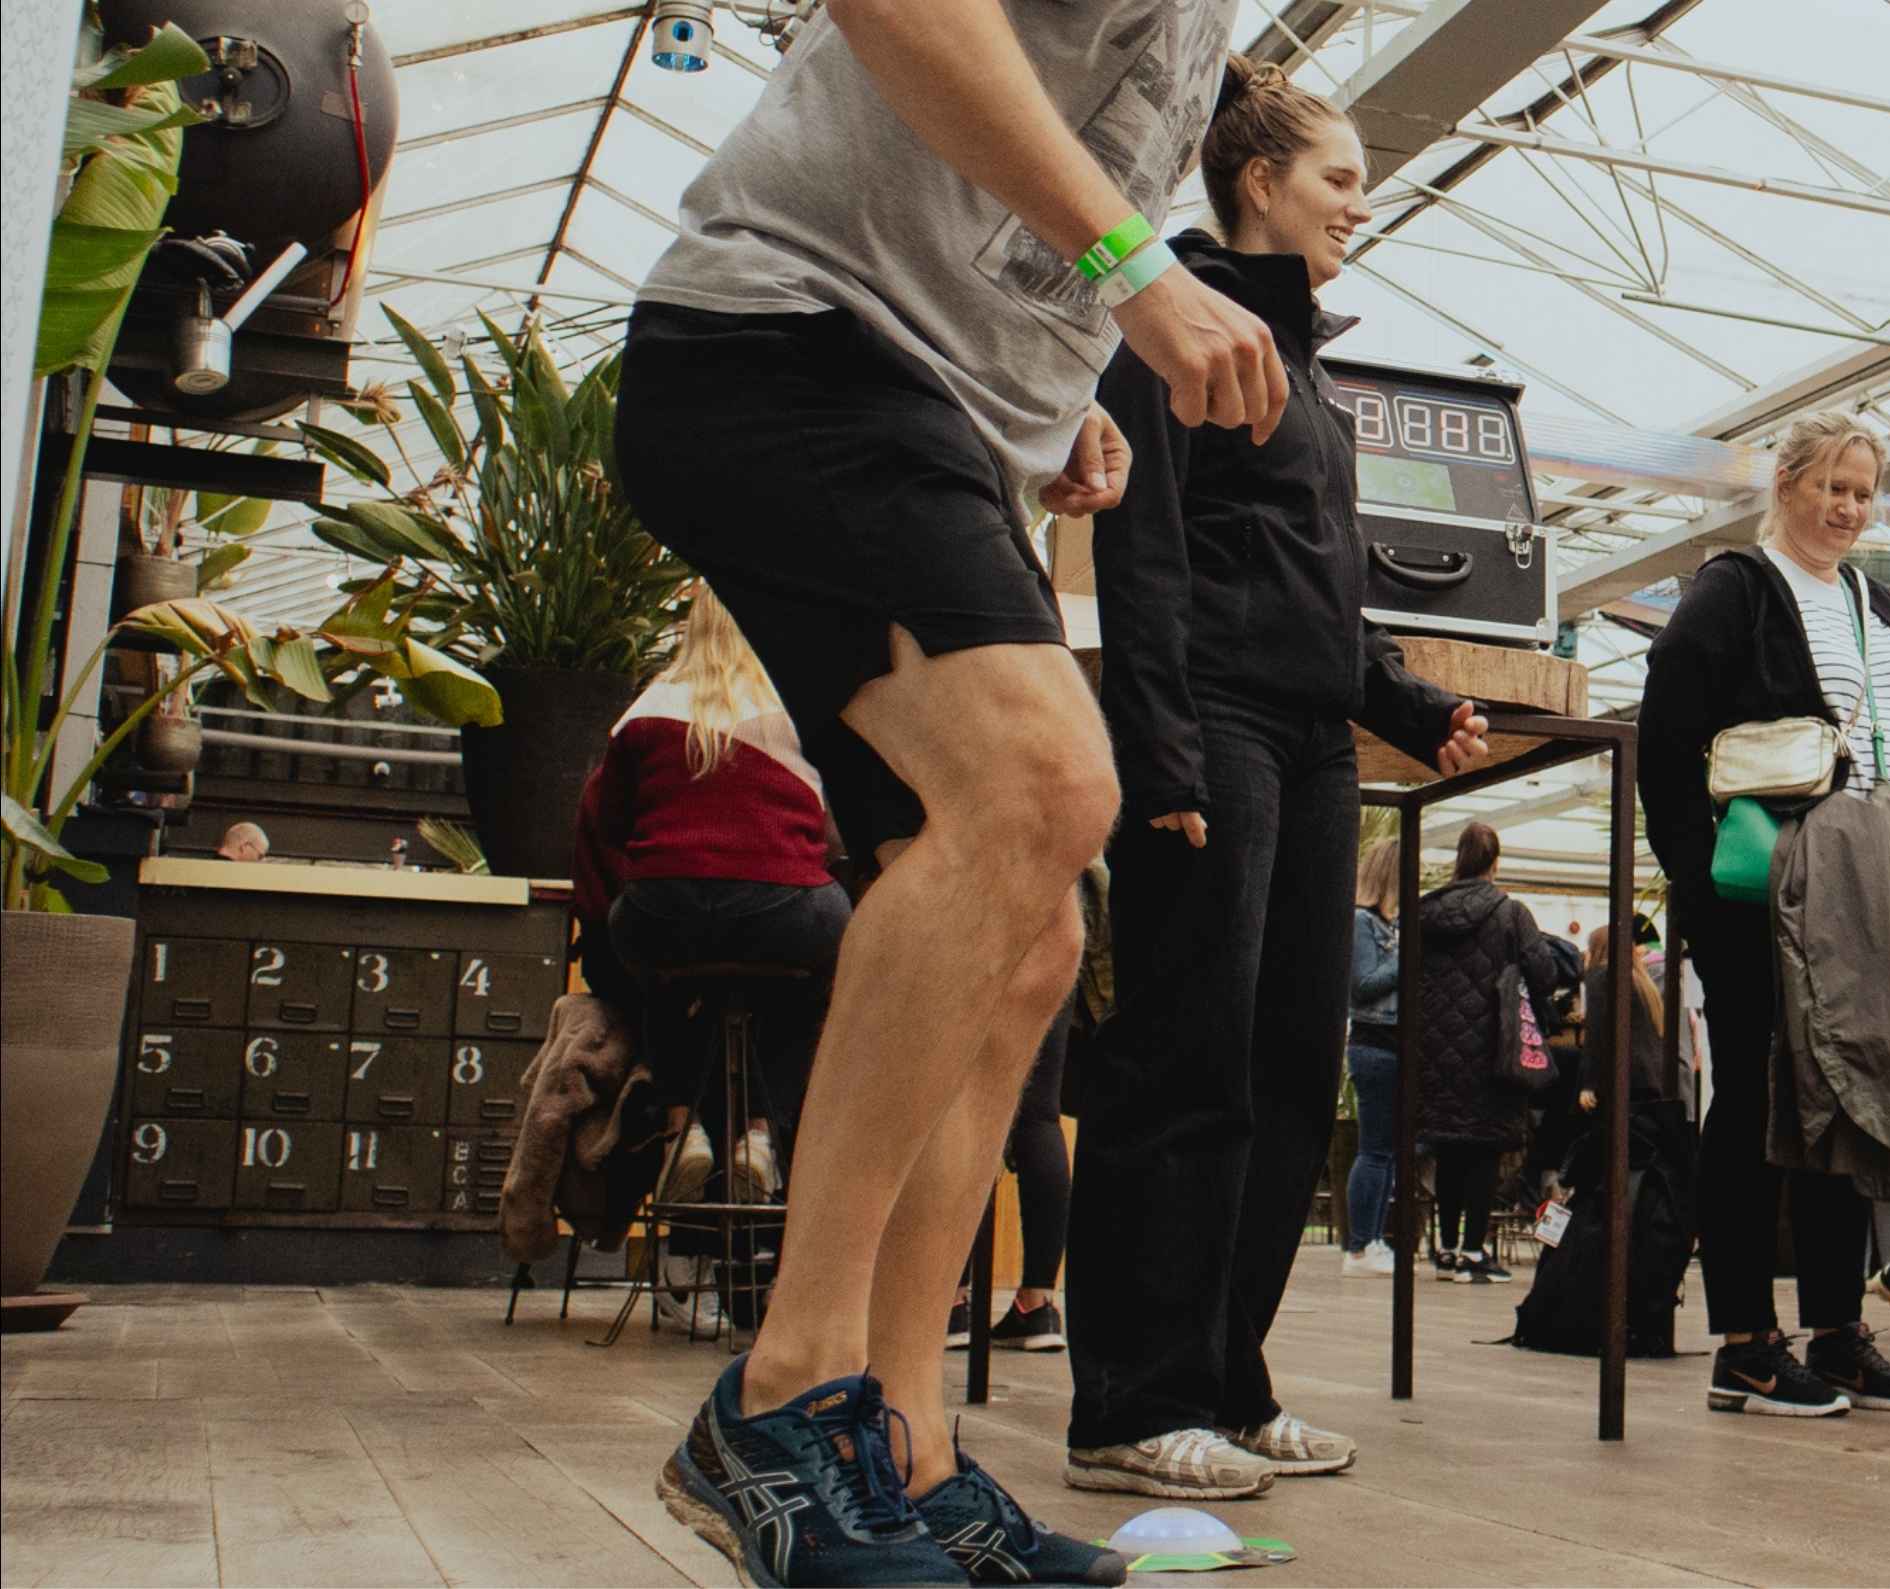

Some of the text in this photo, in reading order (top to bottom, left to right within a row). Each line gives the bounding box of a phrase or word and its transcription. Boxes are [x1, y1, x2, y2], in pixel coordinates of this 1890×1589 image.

[153, 943, 167, 982] 1
[251, 947, 285, 986] 2
[357, 954, 389, 992] 3
[460, 958, 491, 996] 4
[137, 1035, 172, 1073] 5
[245, 1037, 278, 1078] 6
[350, 1041, 381, 1080] 7
[453, 1046, 483, 1084] 8
[132, 1123, 168, 1164] 9
[242, 1127, 292, 1167] 10
[349, 1132, 379, 1170] 11
[453, 1165, 468, 1184] C
[452, 1191, 468, 1210] A
